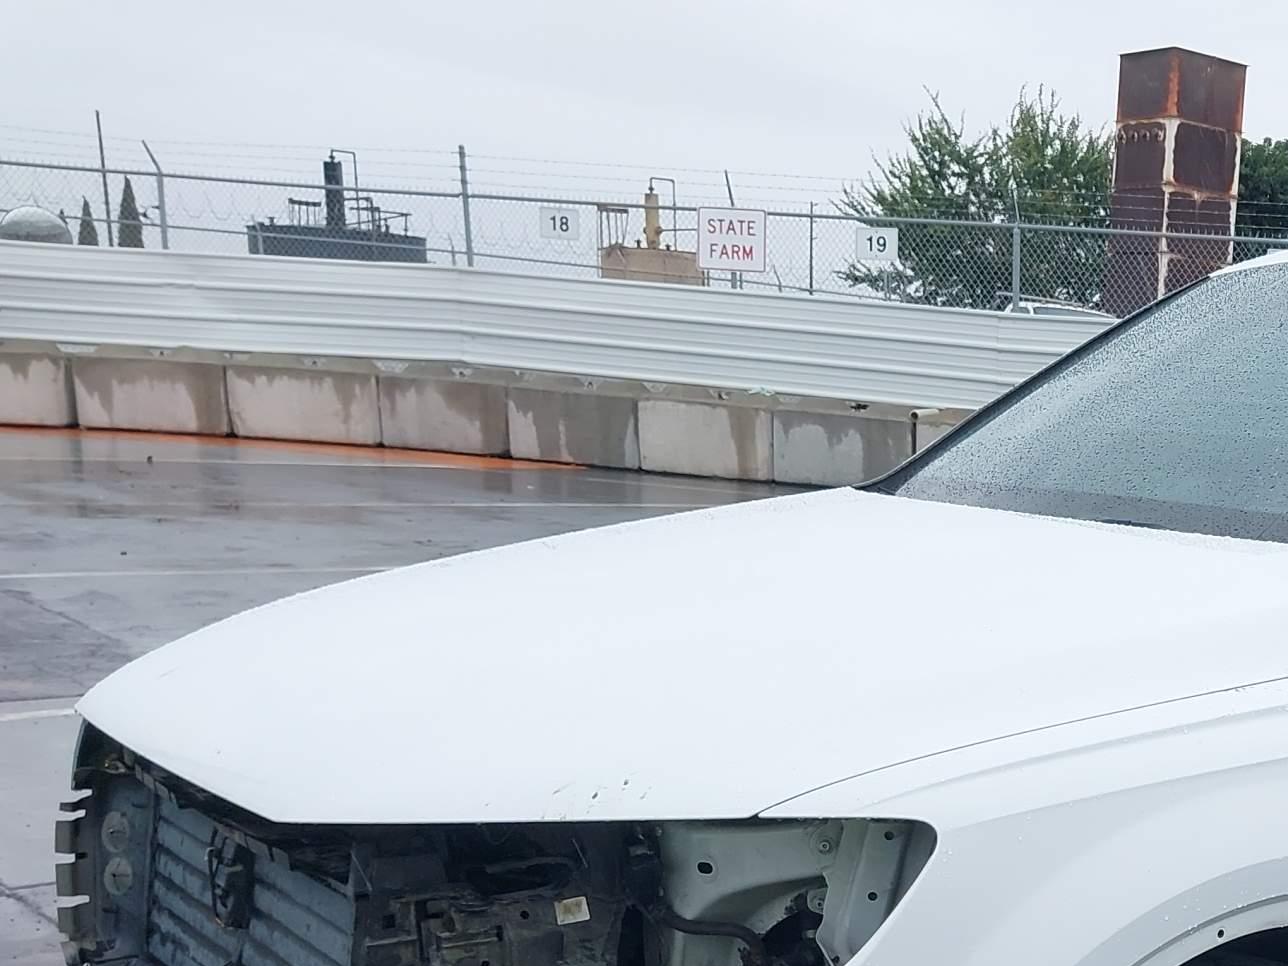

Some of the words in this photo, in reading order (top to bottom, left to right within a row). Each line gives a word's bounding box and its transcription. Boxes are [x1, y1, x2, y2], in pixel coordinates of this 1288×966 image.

[550, 215, 569, 233] 18
[707, 218, 757, 237] STATE
[709, 242, 754, 262] FARM
[866, 235, 887, 253] 19
